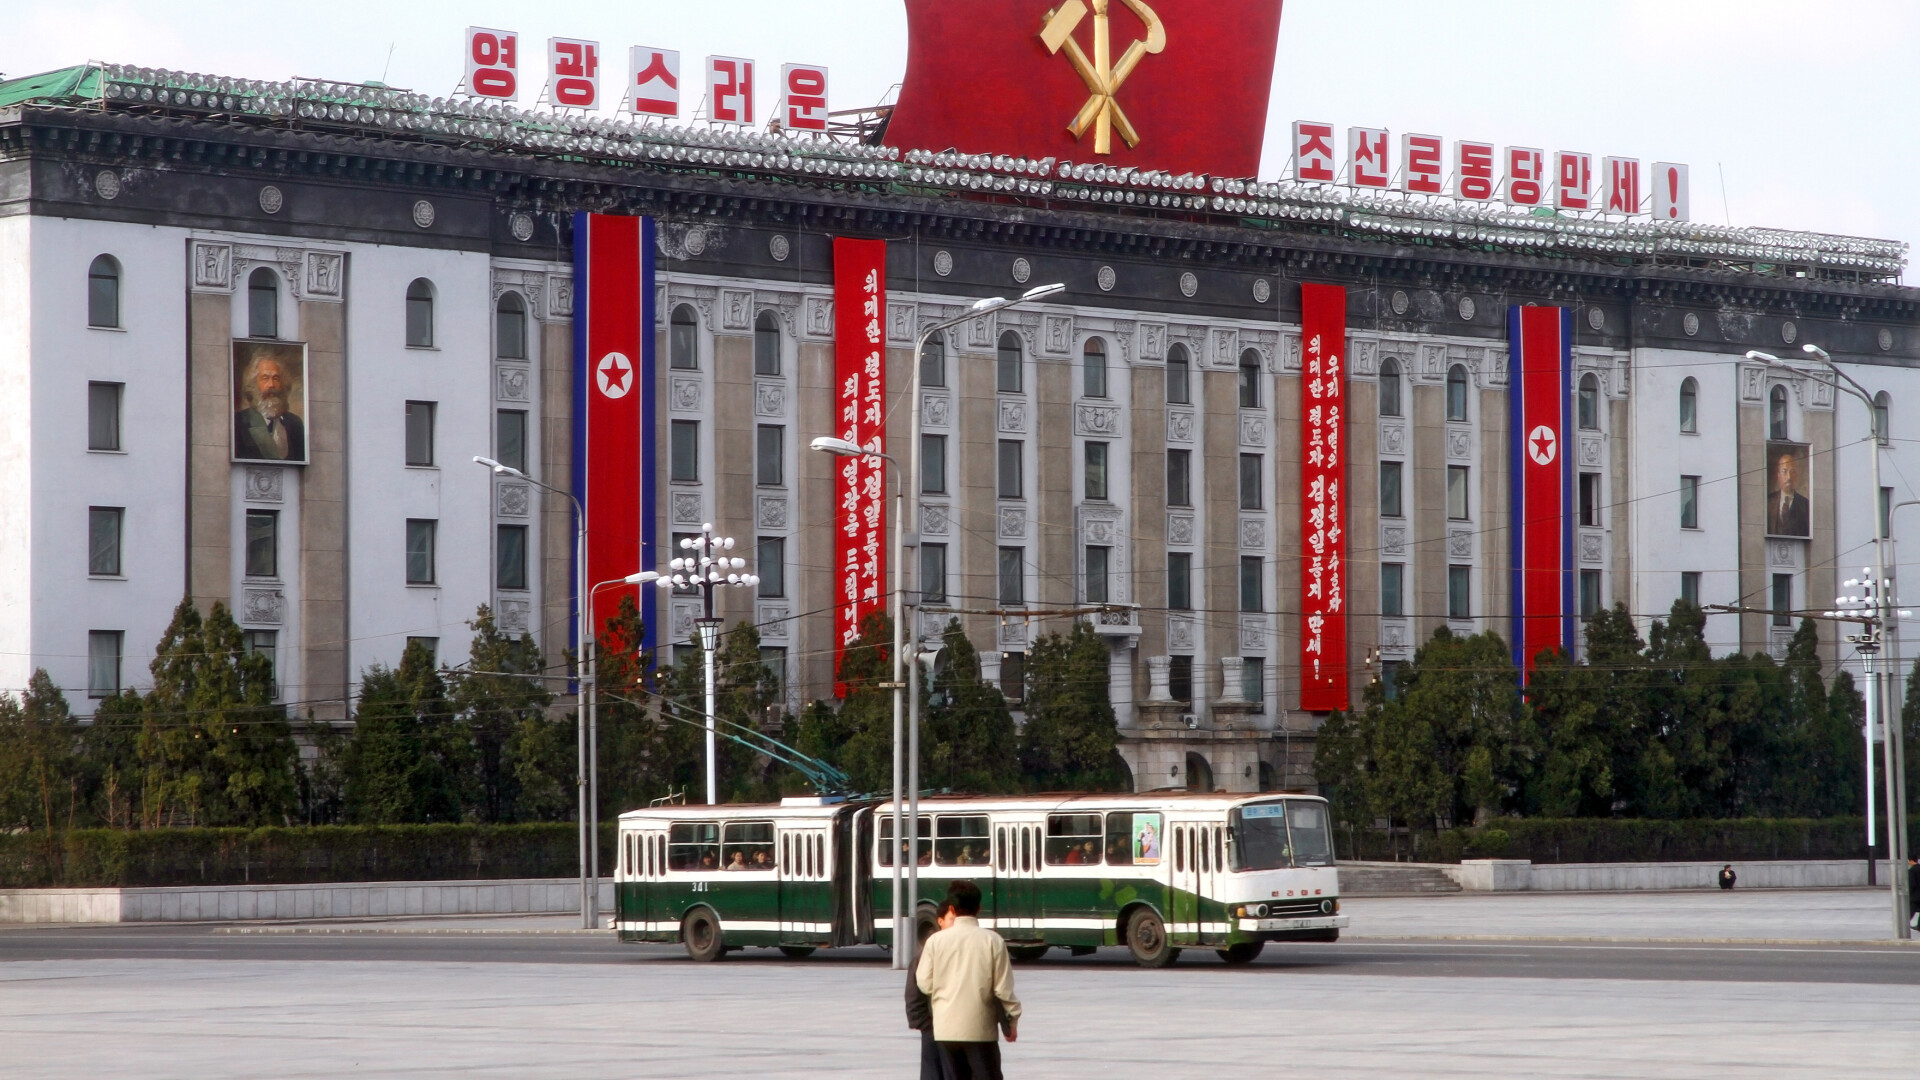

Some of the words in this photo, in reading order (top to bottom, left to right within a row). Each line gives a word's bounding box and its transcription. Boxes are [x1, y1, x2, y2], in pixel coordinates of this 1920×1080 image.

[472, 32, 826, 130] 영광스러운
[863, 268, 881, 344] 위대한
[864, 350, 882, 427] 령도자
[1308, 333, 1324, 399] 위대한
[1326, 354, 1340, 398] 우리
[1308, 404, 1325, 468] 령도자
[842, 458, 860, 538] 영광을
[1326, 477, 1342, 544] 영원한
[1307, 474, 1325, 600] 김정일동지
[843, 547, 861, 646] 드립니다
[1327, 549, 1342, 613] 수호자
[1306, 609, 1325, 681] 만세!
